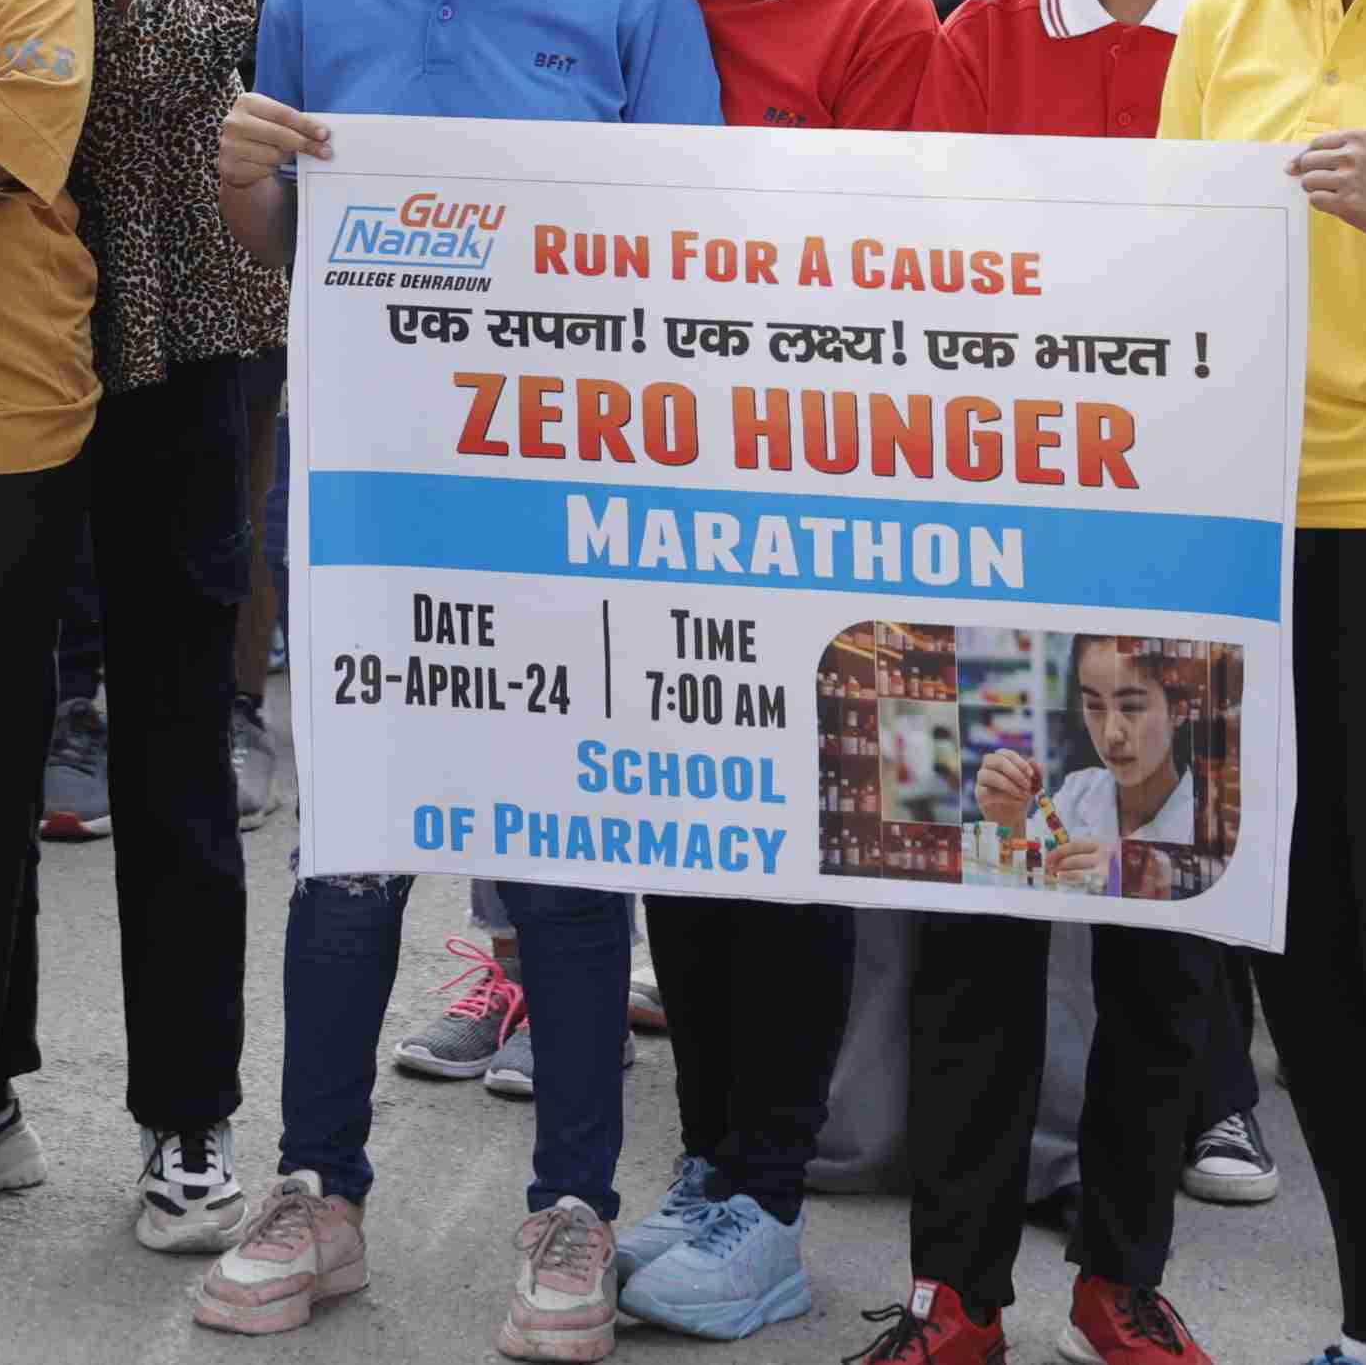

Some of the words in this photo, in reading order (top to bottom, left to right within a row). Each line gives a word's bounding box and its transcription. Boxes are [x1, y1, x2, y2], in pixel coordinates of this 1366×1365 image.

[346, 219, 481, 258] Nanak
[400, 192, 506, 230] Guru
[324, 270, 396, 288] COLLEGE
[400, 273, 492, 292] DEHRADUN
[534, 224, 649, 279] RUN
[672, 231, 780, 285] FOR
[798, 236, 832, 288] A
[851, 239, 1043, 296] CAUSE
[387, 304, 473, 345] एक
[485, 308, 647, 354] सपना!
[664, 317, 753, 359] एक
[767, 320, 908, 367] लक्ष्य!
[923, 327, 1019, 371] एक
[1035, 334, 1171, 377] भारत
[453, 371, 699, 467] ZERO
[731, 387, 1140, 490] HUNGER
[566, 496, 1024, 590] MARATHON
[413, 593, 495, 648] DATE
[670, 608, 757, 664] TIME
[334, 653, 571, 715] 29-APRIL-24
[645, 670, 723, 726] 7:00
[734, 683, 787, 729] AM
[577, 740, 786, 804] SCHOOL
[414, 804, 475, 852] OF
[494, 803, 787, 875] PHARMACY
